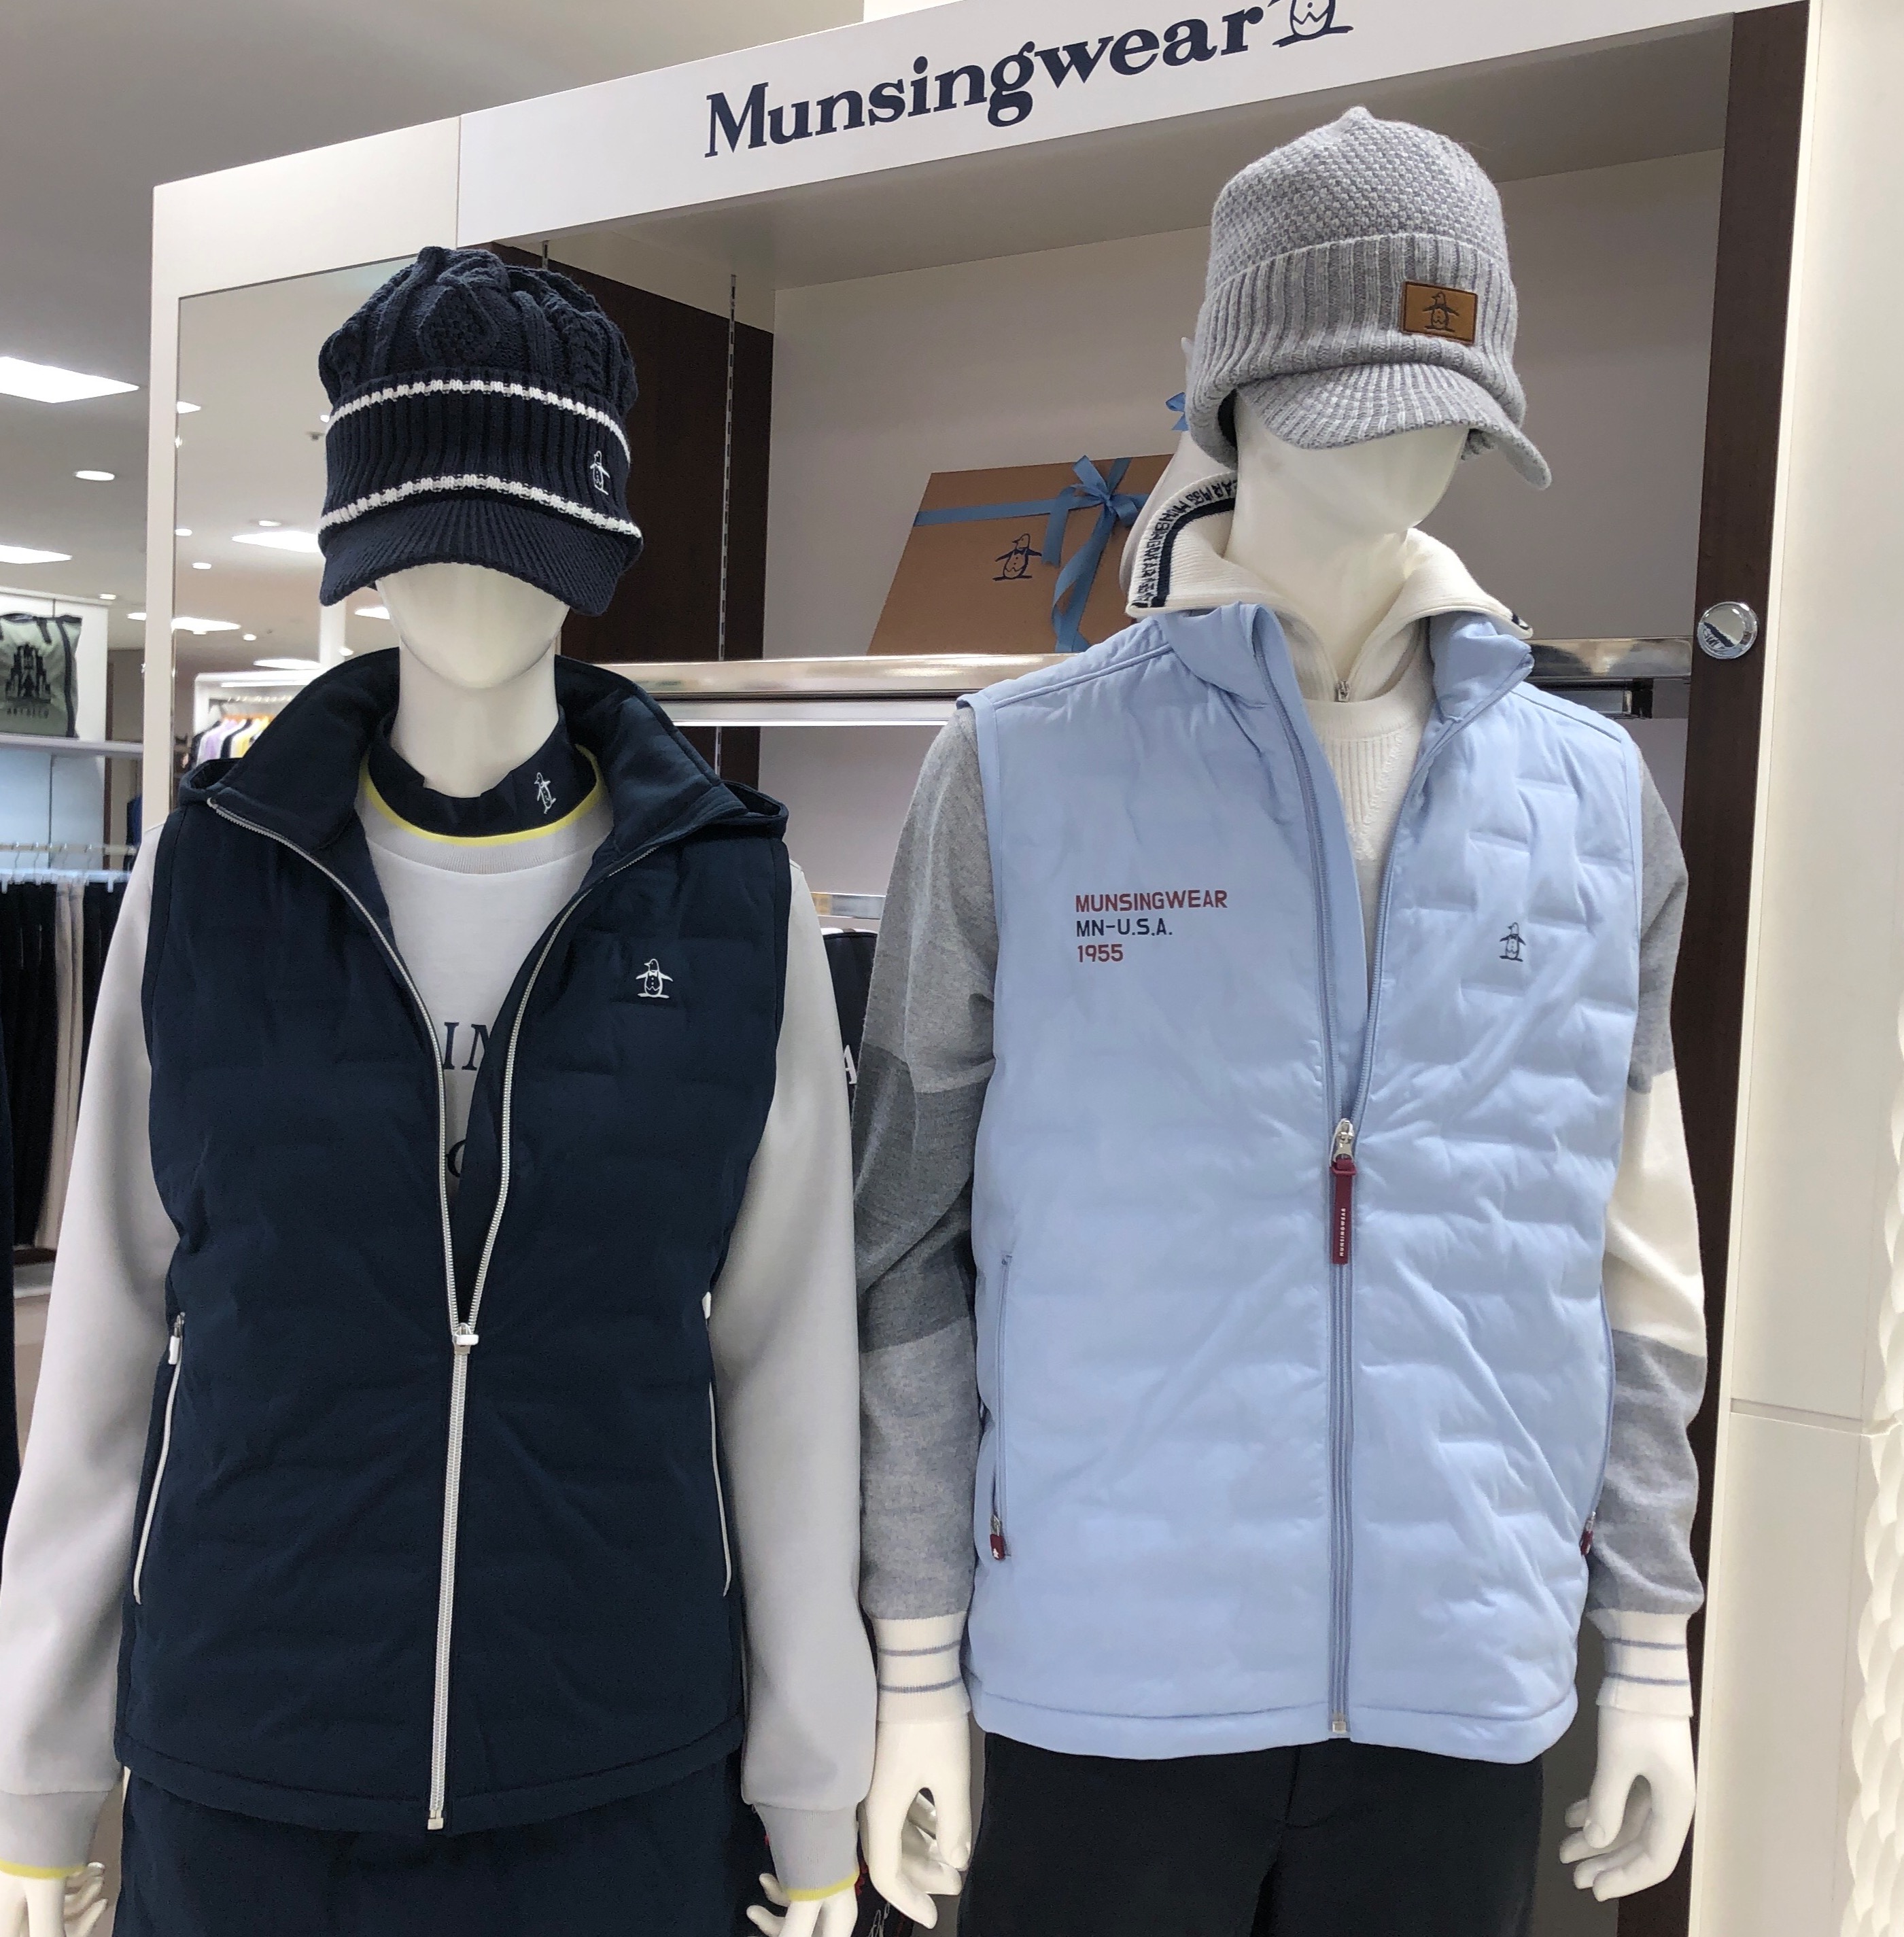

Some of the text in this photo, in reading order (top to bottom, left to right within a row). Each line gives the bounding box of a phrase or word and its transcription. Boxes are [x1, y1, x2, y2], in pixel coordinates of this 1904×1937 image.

[704, 5, 1264, 158] Munsingwear
[1075, 890, 1228, 912] MUNSINGWEAR
[1076, 918, 1173, 937] MN-U.S.A.
[1077, 943, 1124, 962] 1955
